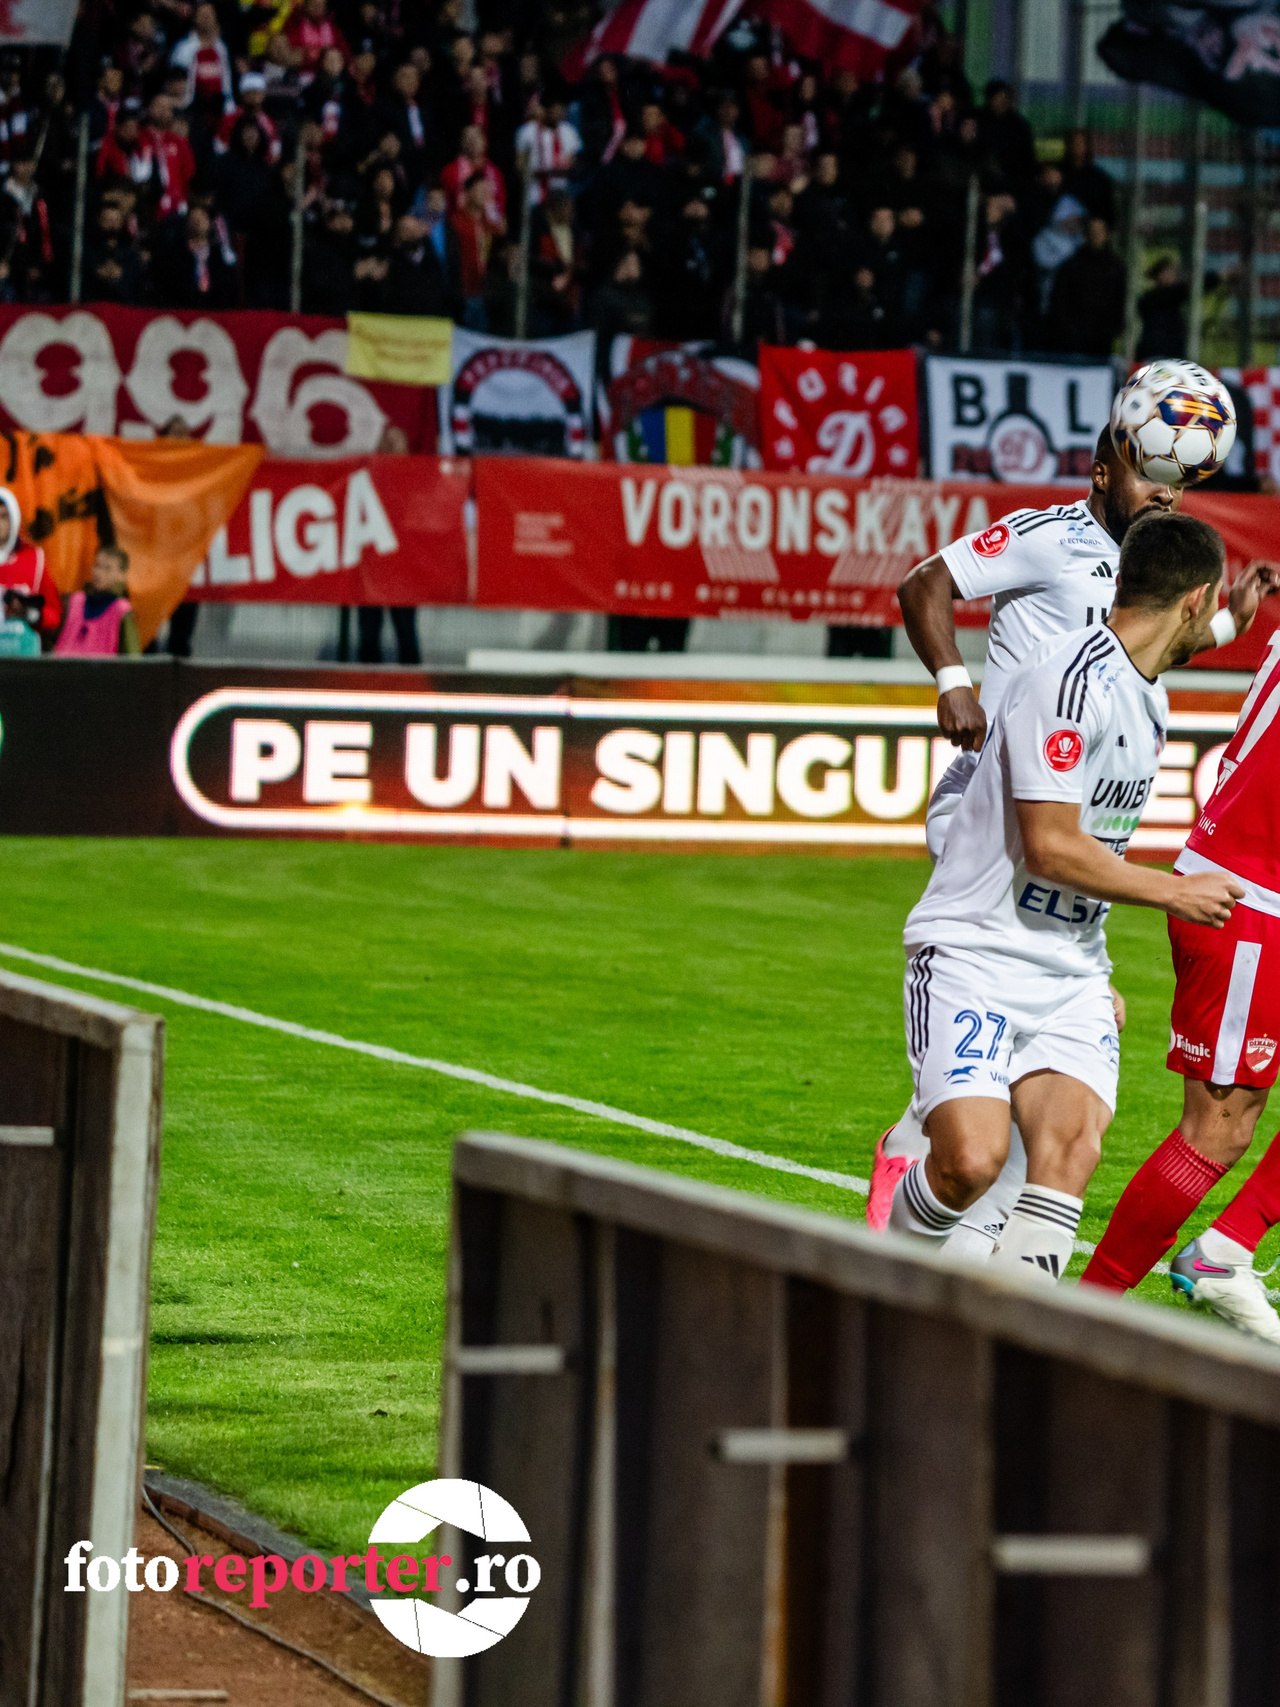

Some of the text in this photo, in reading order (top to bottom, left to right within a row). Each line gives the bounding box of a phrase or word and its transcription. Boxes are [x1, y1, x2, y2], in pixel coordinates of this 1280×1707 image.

[191, 468, 398, 588] LIGA
[229, 718, 374, 803] PE
[403, 722, 563, 811] UN
[589, 727, 945, 820] SINGU
[953, 1008, 1007, 1062] 27
[1175, 1033, 1211, 1059] Tehnic
